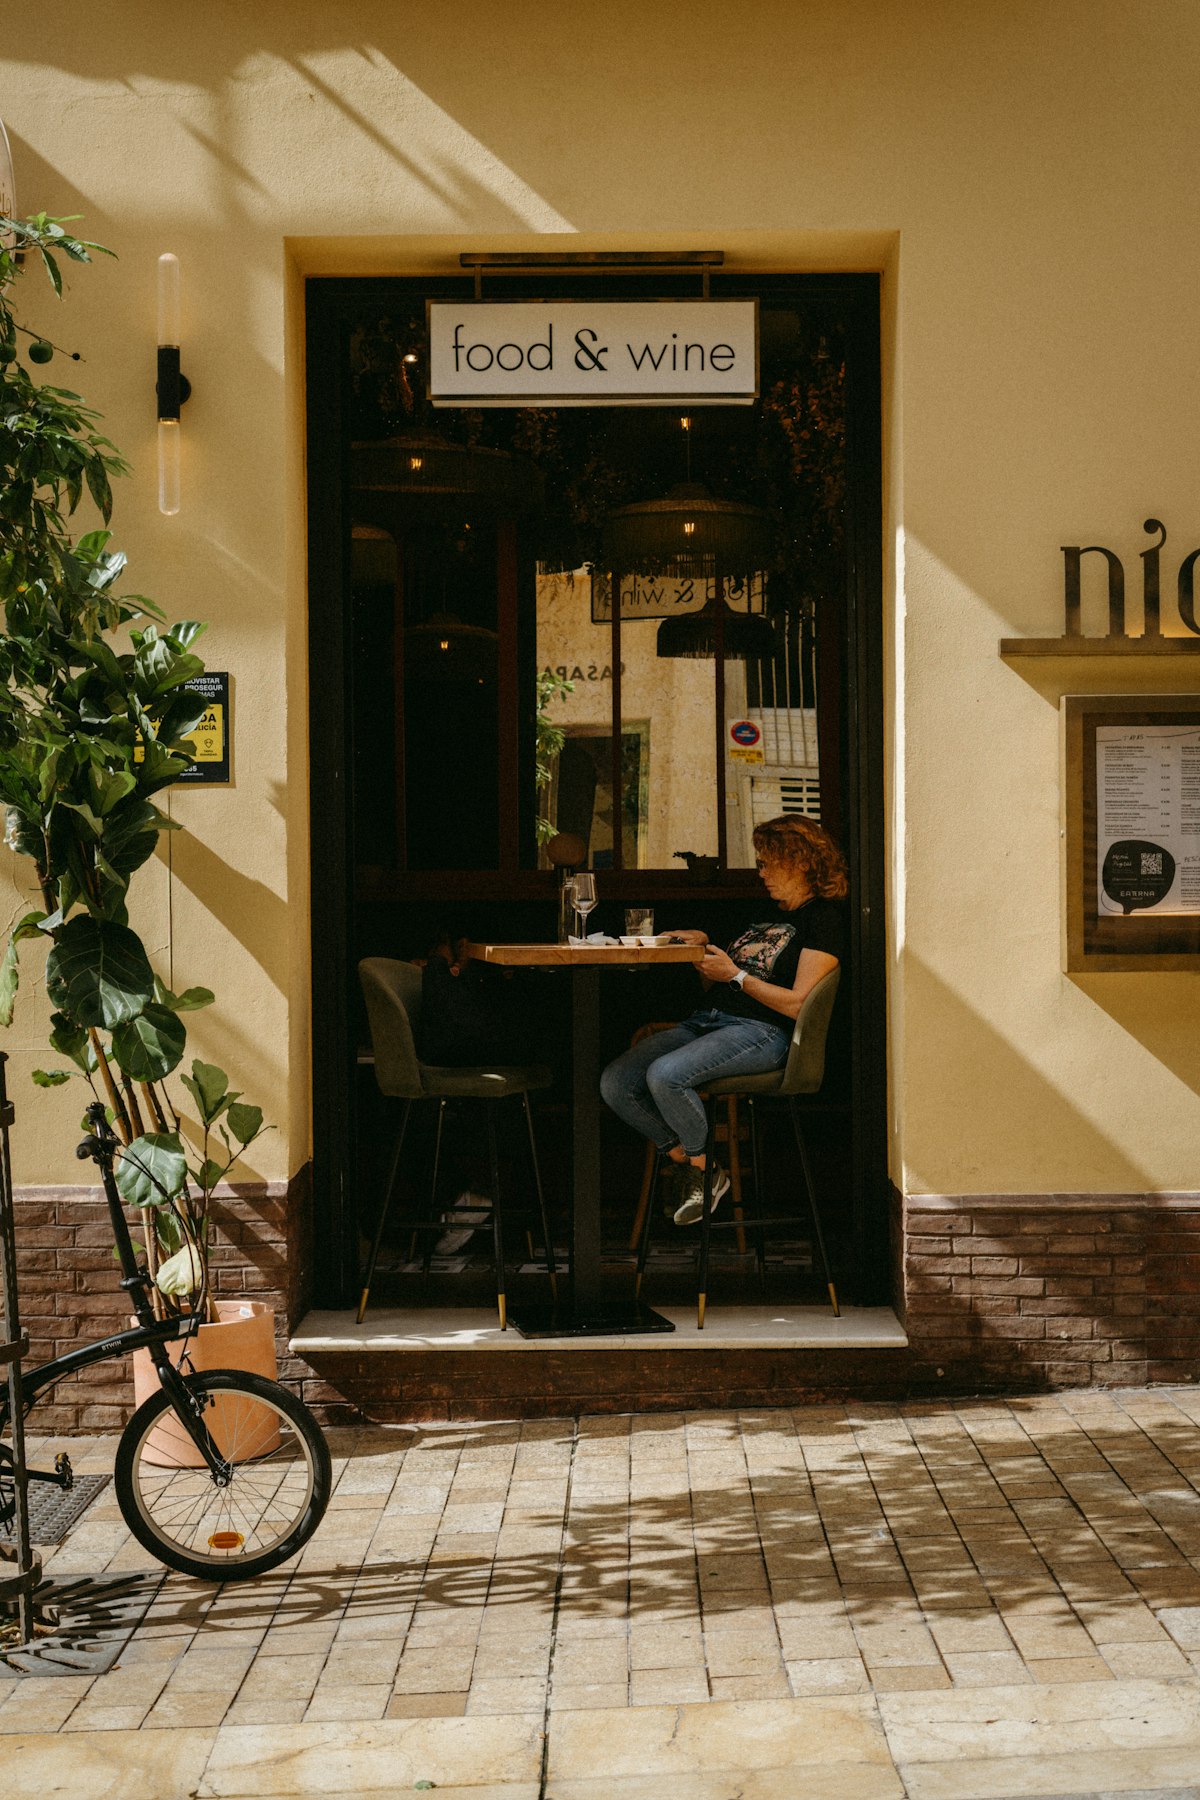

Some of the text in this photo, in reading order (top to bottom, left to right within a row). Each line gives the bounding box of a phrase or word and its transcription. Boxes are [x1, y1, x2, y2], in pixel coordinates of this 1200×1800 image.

[452, 323, 736, 372] food & wine
[1184, 855, 1200, 863] PESC
